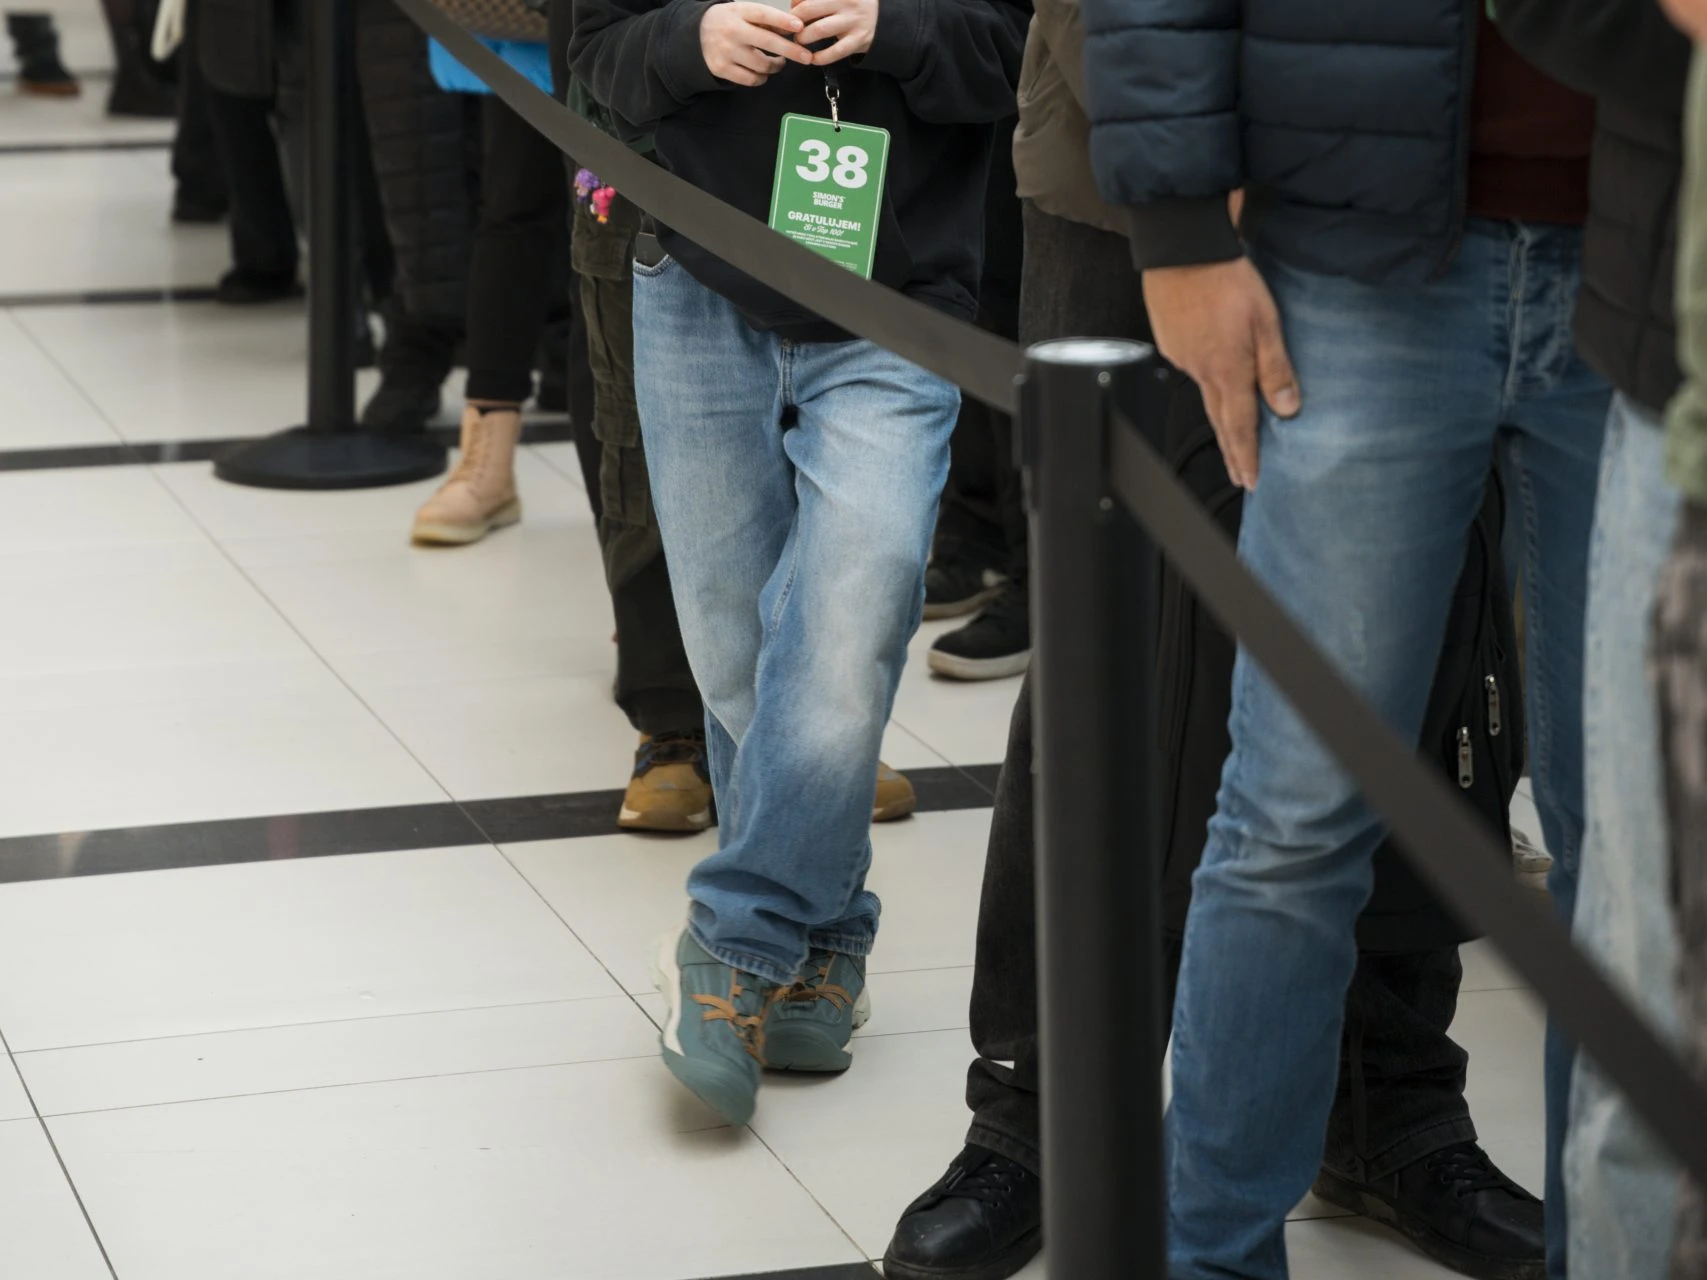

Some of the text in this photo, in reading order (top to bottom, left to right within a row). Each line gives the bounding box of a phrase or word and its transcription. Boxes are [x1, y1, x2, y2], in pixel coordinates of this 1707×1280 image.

[795, 139, 869, 189] 38
[812, 191, 844, 203] SIMON'S
[813, 198, 843, 210] BURGER
[787, 210, 862, 232] GRATULUJEM!
